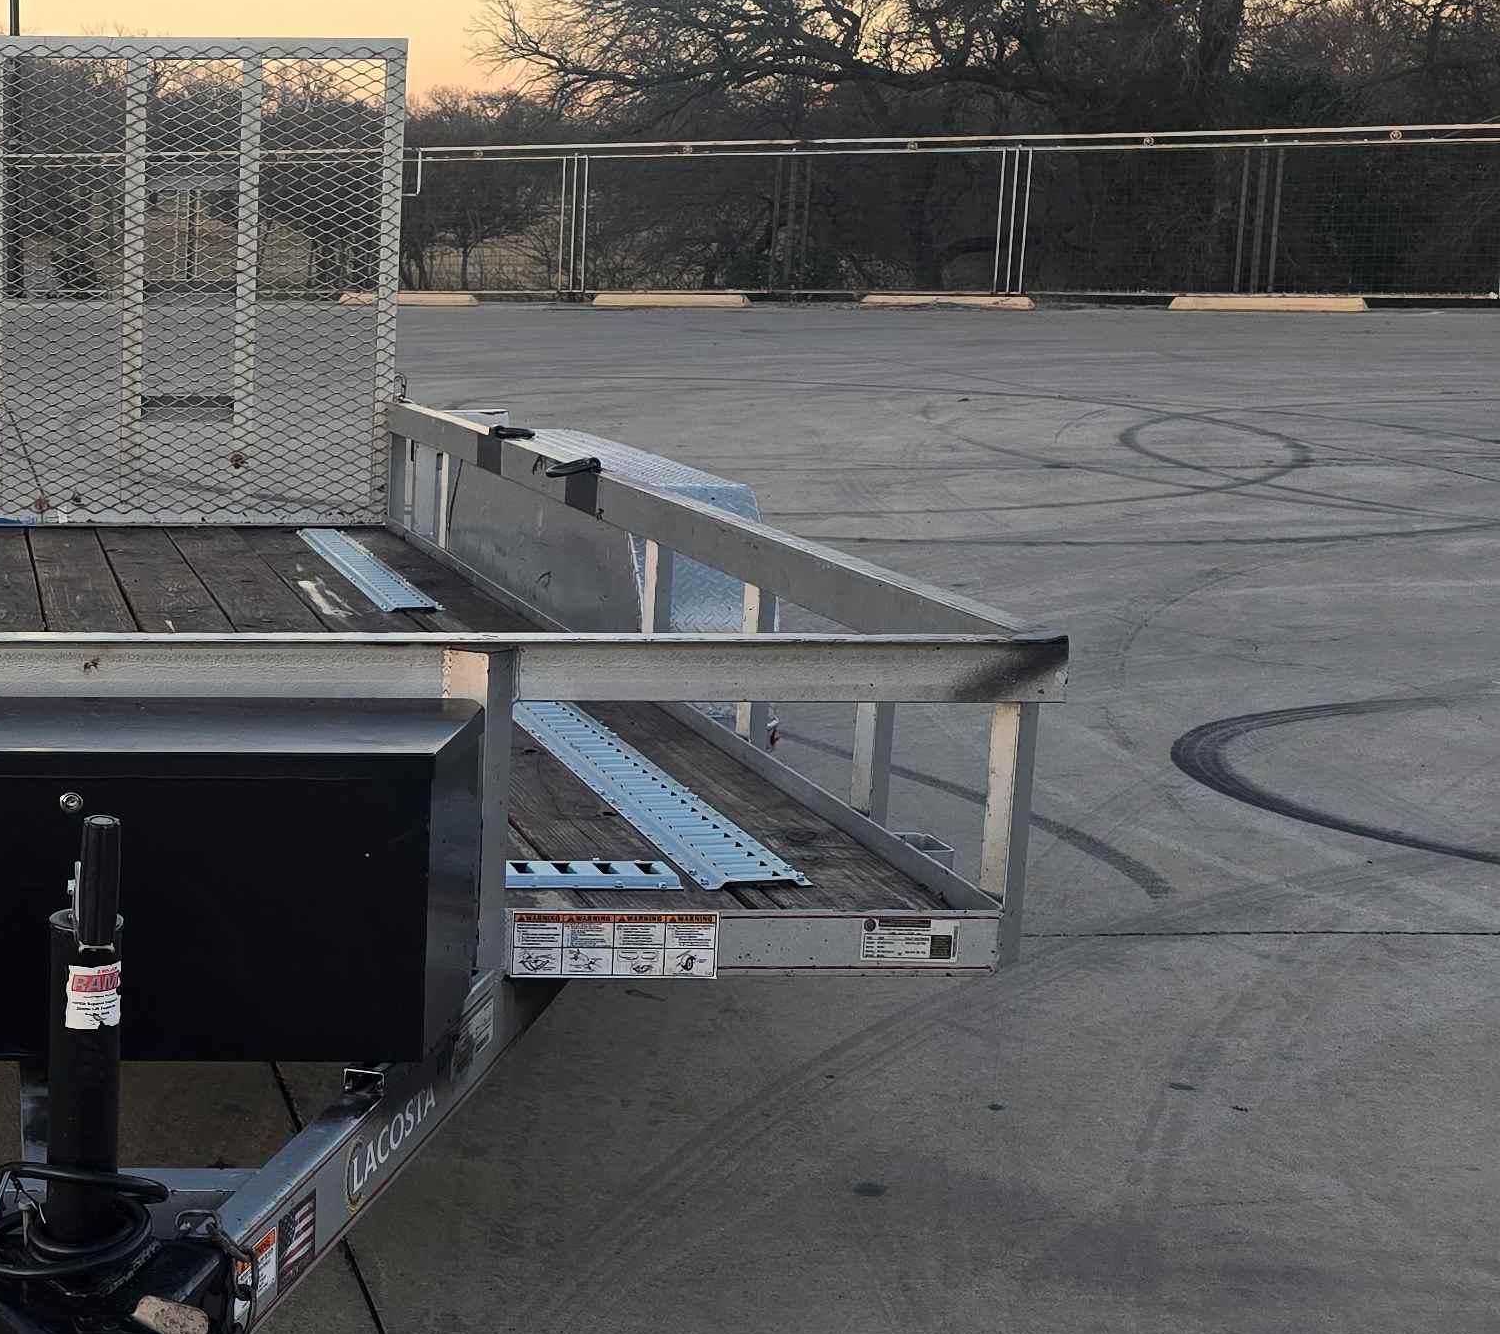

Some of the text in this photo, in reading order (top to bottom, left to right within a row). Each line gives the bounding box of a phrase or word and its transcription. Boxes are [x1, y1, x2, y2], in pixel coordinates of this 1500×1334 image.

[678, 915, 713, 923] WARNING
[73, 973, 119, 991] RAM
[352, 1083, 436, 1194] LACOSTA
